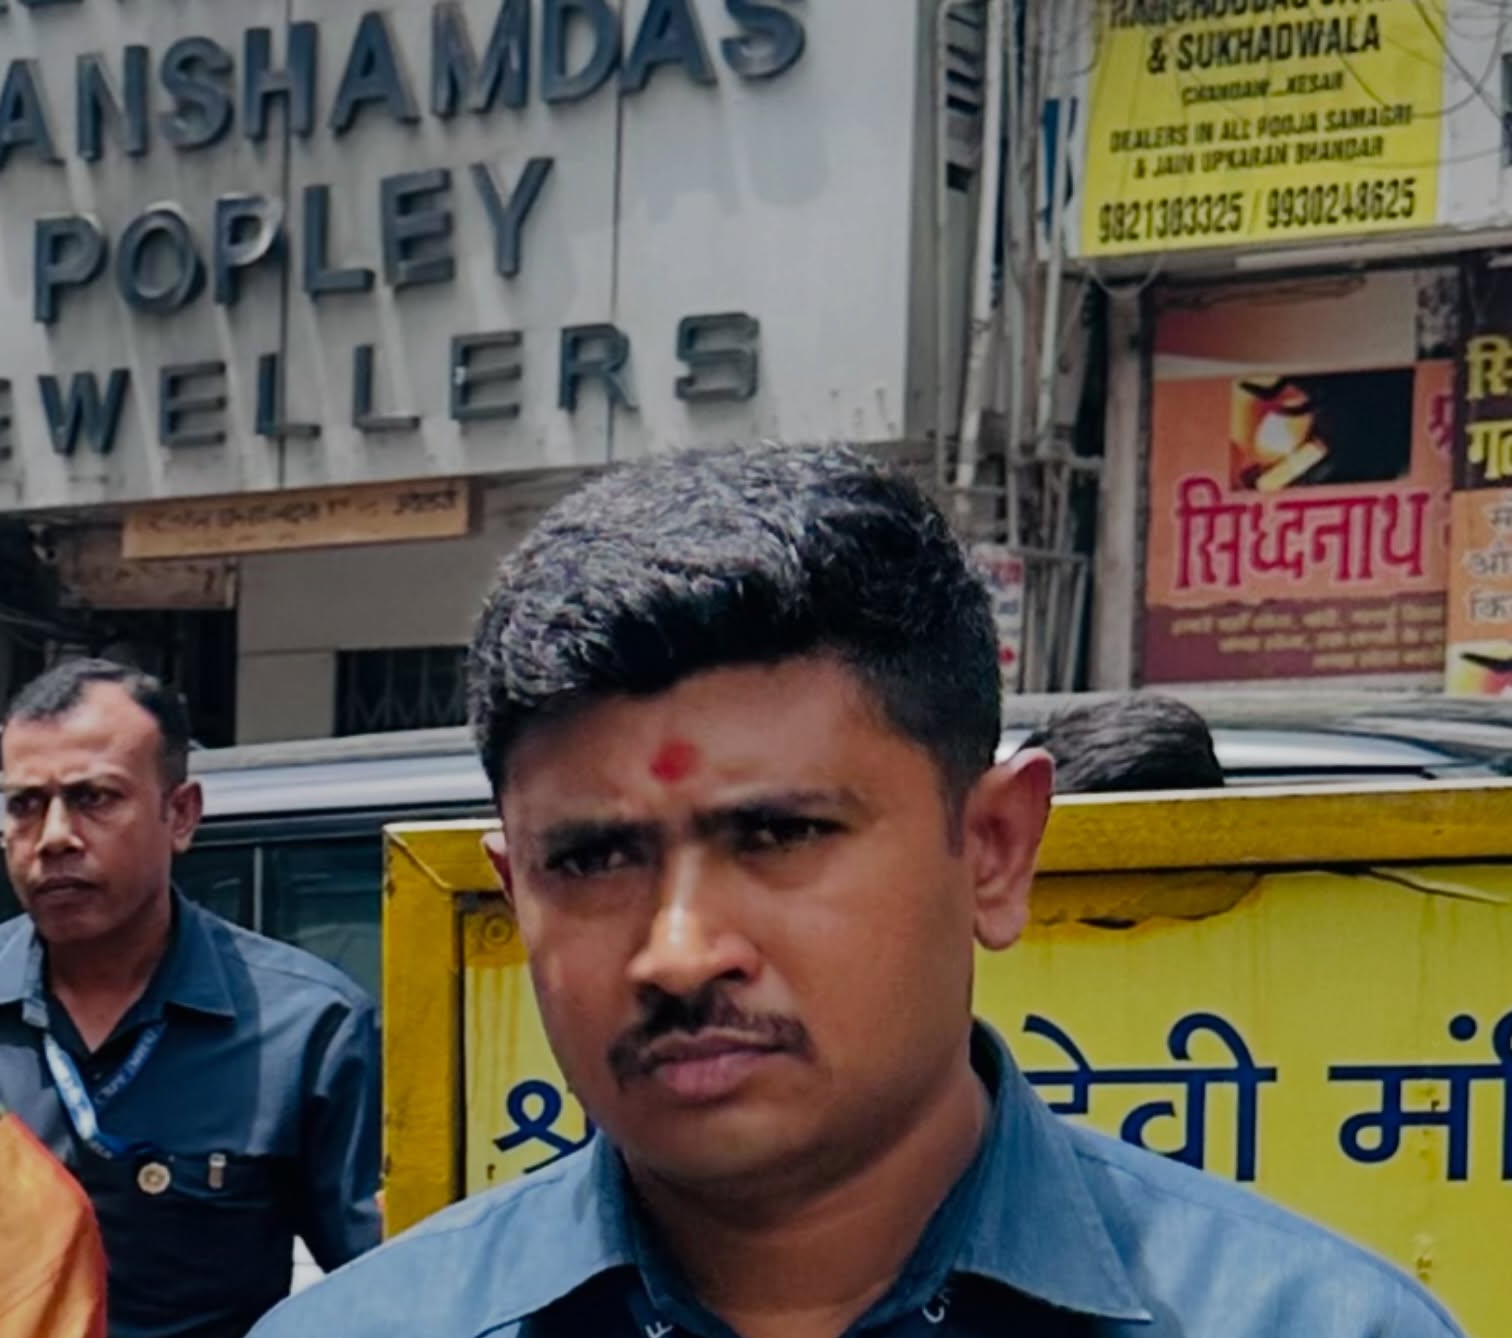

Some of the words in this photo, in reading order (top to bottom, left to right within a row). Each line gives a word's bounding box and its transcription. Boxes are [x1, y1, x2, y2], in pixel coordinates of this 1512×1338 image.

[1146, 34, 1168, 76] &
[1176, 13, 1381, 72] SUKHADWALA
[1109, 123, 1188, 154] DEALERS
[1193, 120, 1215, 143] IN
[1220, 116, 1250, 141] ALL
[1257, 110, 1318, 138] POOJA
[1324, 104, 1414, 133] SAMAGRI
[1152, 152, 1196, 177] JAIN
[1200, 144, 1289, 174] UPKARAN
[1294, 135, 1385, 165] BHANDAR
[33, 156, 553, 326] POPLEY
